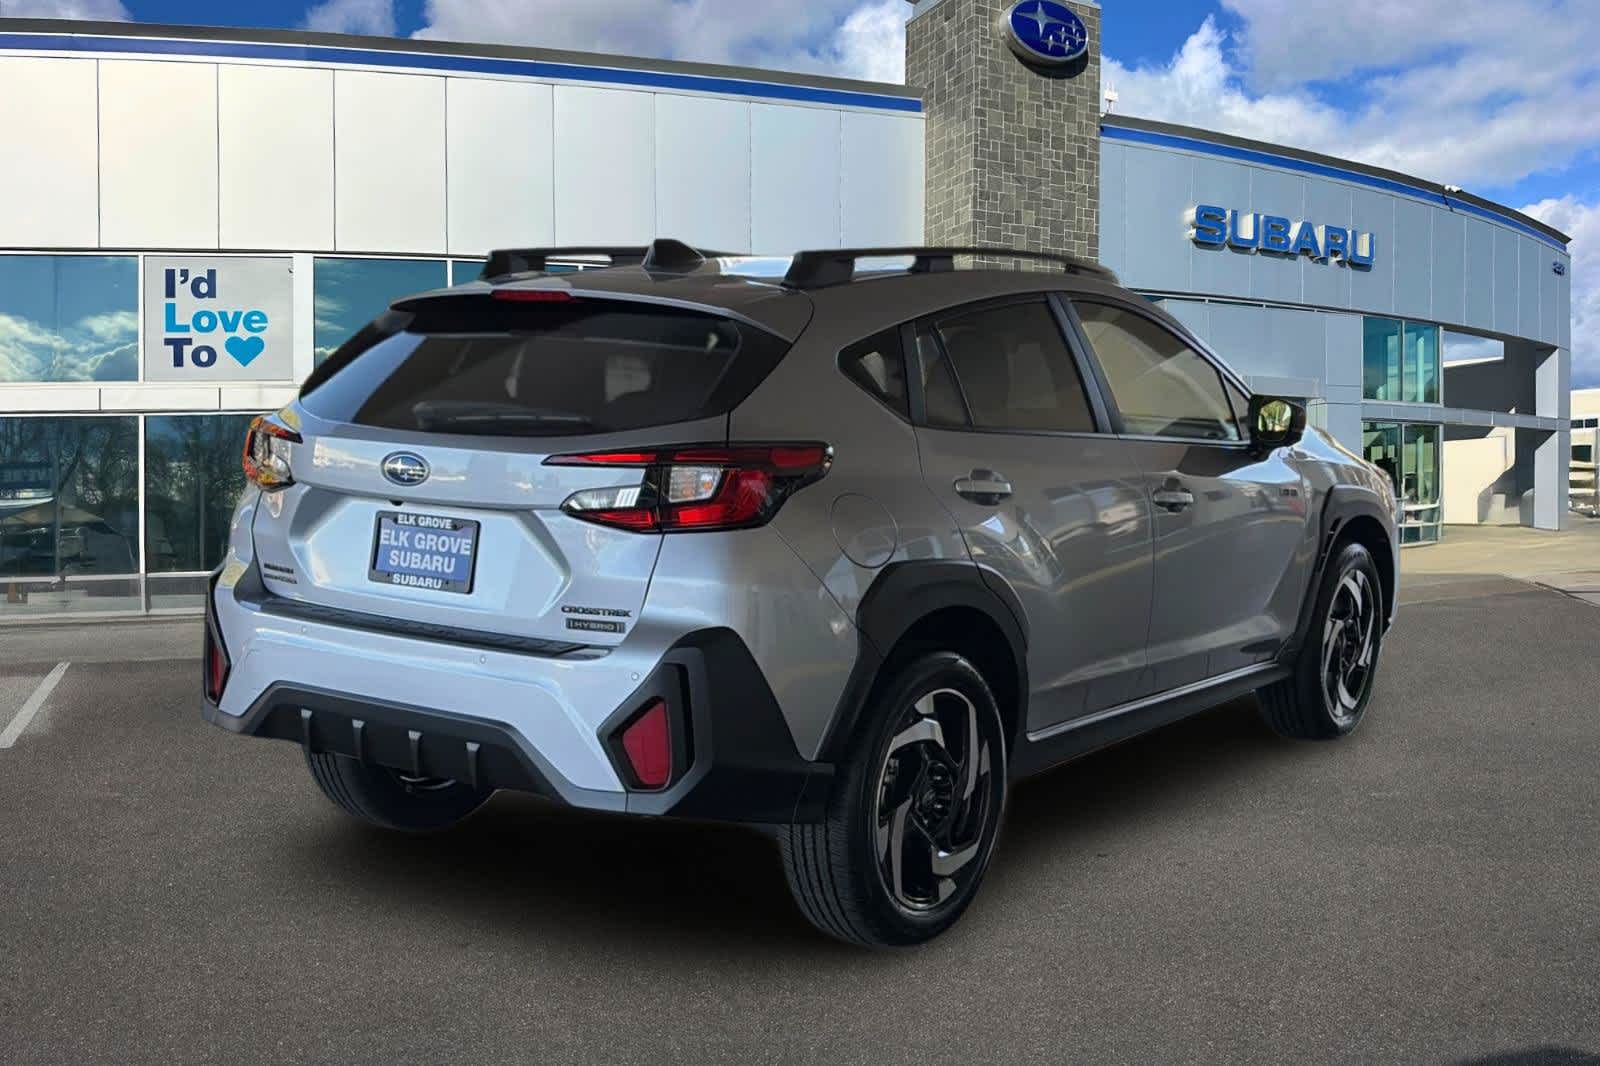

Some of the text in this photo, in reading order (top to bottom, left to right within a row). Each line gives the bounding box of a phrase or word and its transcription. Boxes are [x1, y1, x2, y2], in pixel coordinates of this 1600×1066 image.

[1192, 204, 1376, 269] SUBARU
[165, 268, 217, 299] I'd
[165, 302, 269, 333] Love
[164, 337, 217, 368] To
[397, 514, 452, 529] ELK GROVE
[380, 529, 472, 555] ELK GROVE
[389, 550, 456, 573] SUBARU
[392, 573, 442, 589] SUBARU
